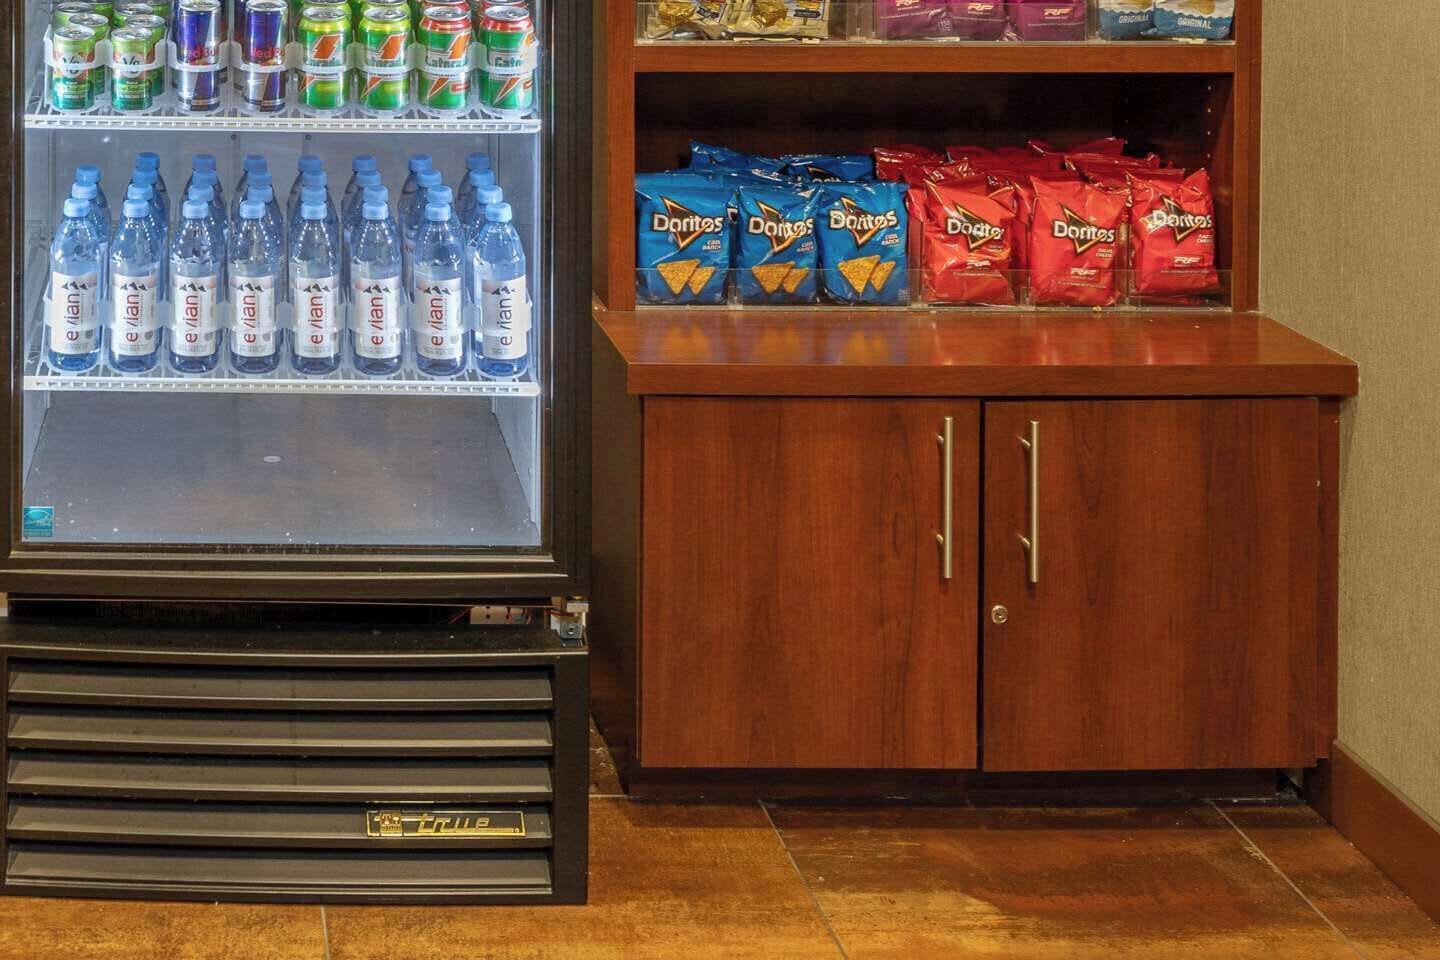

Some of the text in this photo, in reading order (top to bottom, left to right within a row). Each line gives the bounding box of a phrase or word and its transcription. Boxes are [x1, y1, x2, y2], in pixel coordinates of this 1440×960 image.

[1178, 17, 1211, 29] ORIGINAL
[653, 214, 723, 232] Doritos
[749, 218, 814, 238] Doritos
[830, 210, 897, 230] Doritos
[948, 219, 1003, 239] Dorito
[1054, 220, 1114, 242] Doritos
